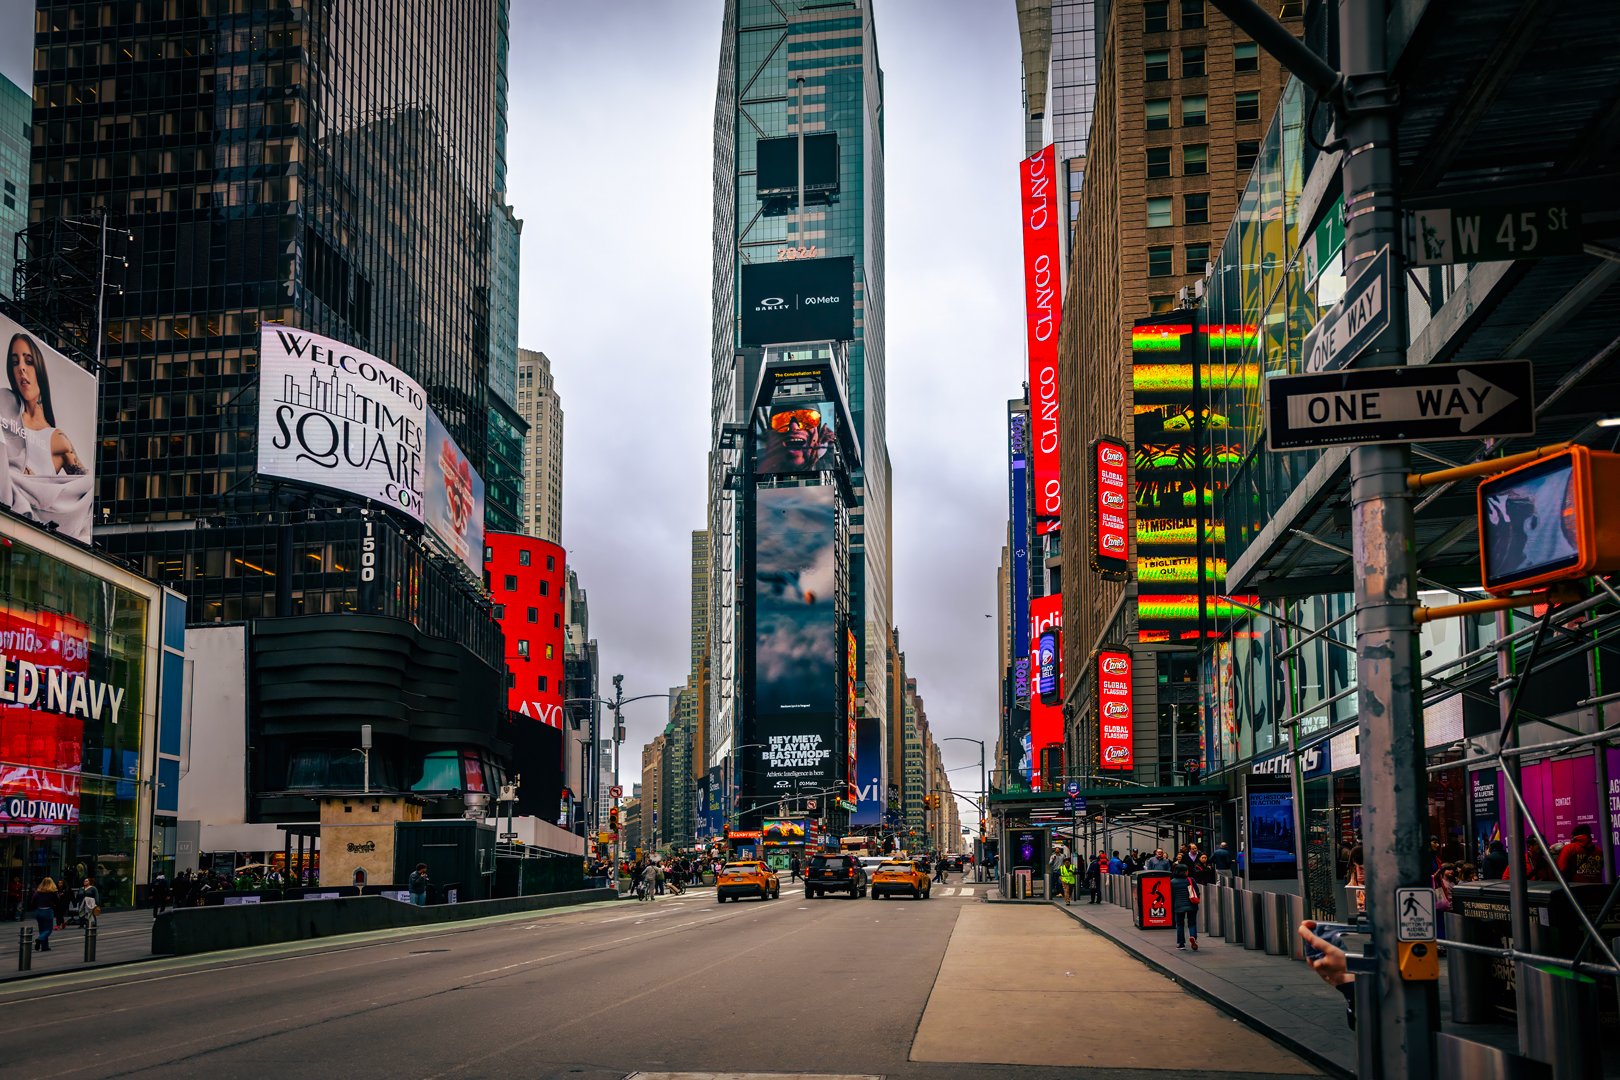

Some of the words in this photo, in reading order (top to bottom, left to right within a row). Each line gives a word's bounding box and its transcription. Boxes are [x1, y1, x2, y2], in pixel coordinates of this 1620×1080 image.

[1326, 217, 1333, 256] 7
[1338, 202, 1344, 226] A
[1456, 215, 1481, 255] W
[1496, 212, 1539, 252] 45
[1547, 207, 1569, 231] St
[817, 296, 840, 304] Meta
[1035, 254, 1054, 342] CLAYCO
[755, 304, 790, 312] OAKLEY
[1313, 328, 1337, 372] ONE
[1347, 285, 1376, 338] WAY
[407, 386, 423, 411] TO
[1308, 392, 1381, 424] ONE
[1416, 386, 1492, 416] WAY
[1040, 366, 1060, 454] CLAYCO
[10, 418, 27, 440] like
[356, 394, 422, 454] TIMES
[272, 404, 422, 496] SQUARE
[1101, 470, 1124, 481] GLOBAL
[1102, 512, 1125, 524] GLOBAL
[1150, 519, 1195, 533] MUSICAL
[361, 522, 375, 582] 1500
[1150, 557, 1191, 568] BIGLIETTI
[0, 654, 39, 706] LD
[47, 667, 125, 724] NAVY
[1103, 681, 1128, 689] GLOBAL
[1103, 688, 1128, 696] FLAGSHIP
[1104, 725, 1128, 734] GLOBAL
[1104, 732, 1128, 740] FLAGSHIP
[768, 735, 792, 745] HEY
[791, 734, 823, 743] META
[771, 743, 799, 752] PLAY
[800, 742, 819, 751] MY
[770, 758, 821, 768] PLAYLIST
[1252, 746, 1322, 774] SKECHRS
[1555, 797, 1572, 806] CONTACT
[10, 798, 36, 819] OLD
[38, 801, 74, 822] NAVY
[1151, 907, 1165, 916] MJ
[1491, 904, 1510, 912] MUSICAL
